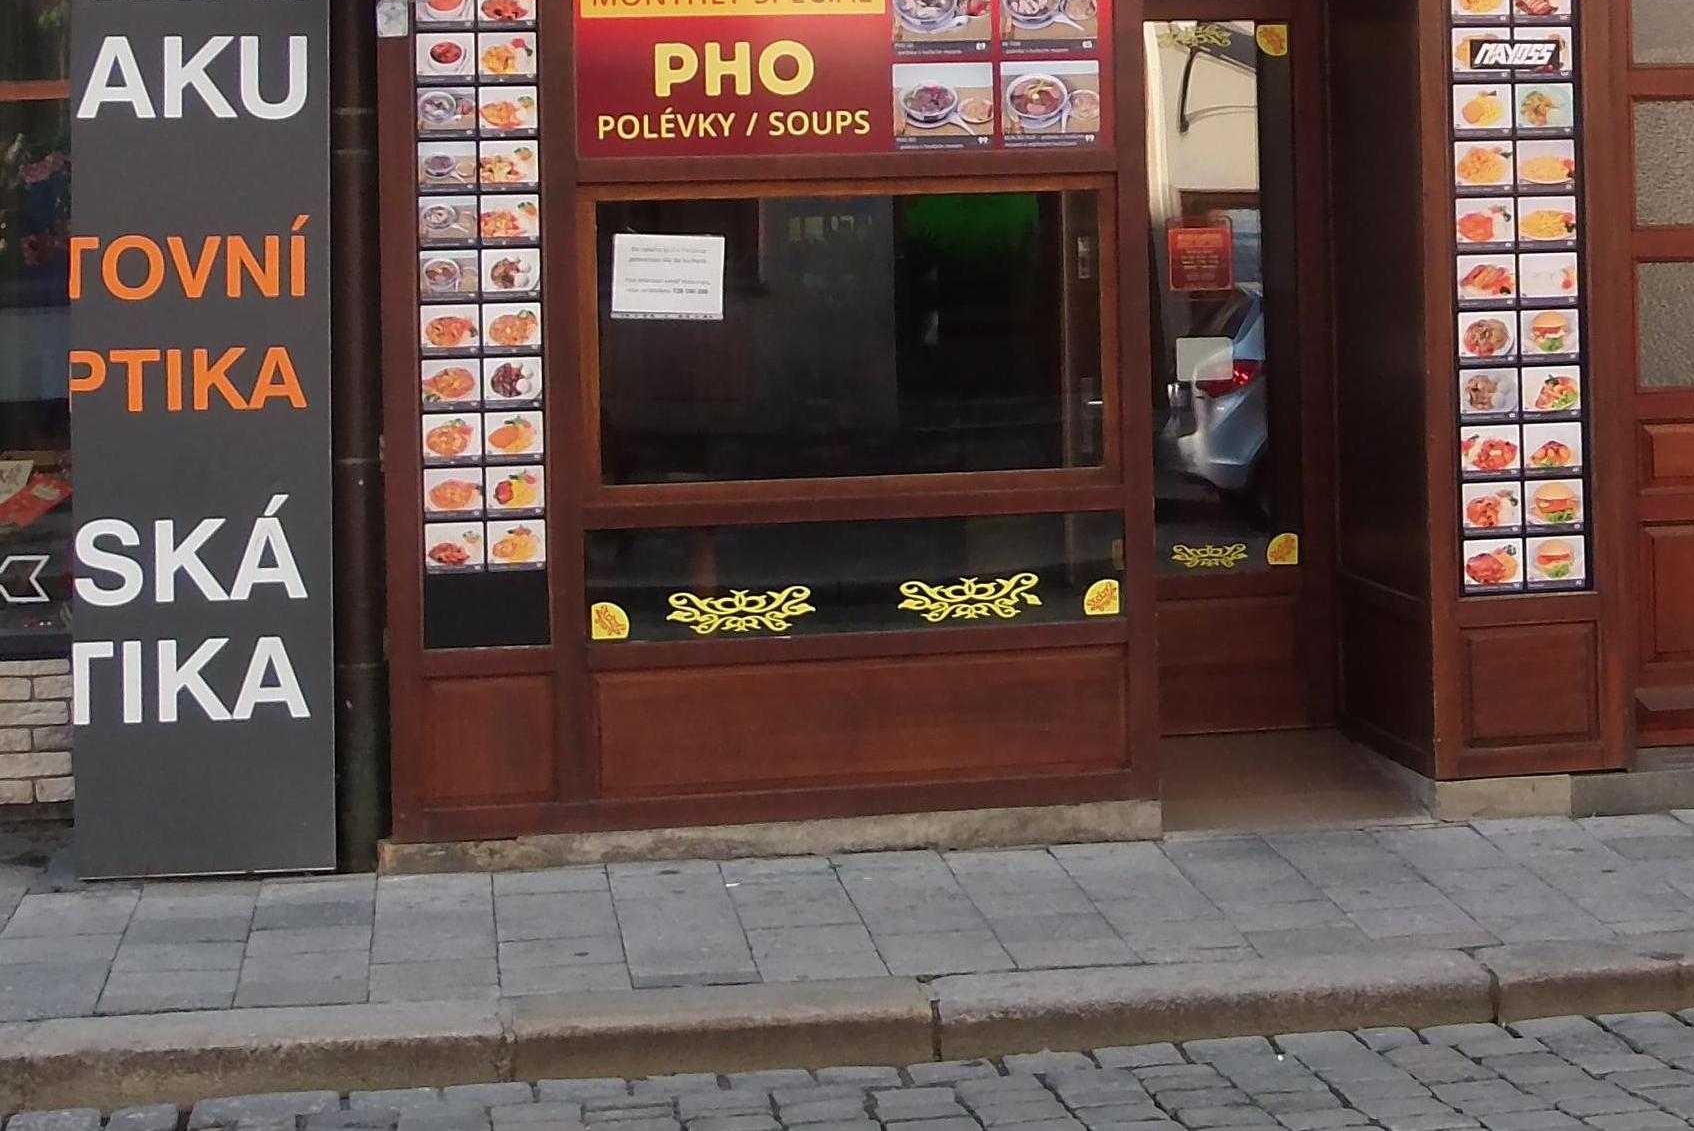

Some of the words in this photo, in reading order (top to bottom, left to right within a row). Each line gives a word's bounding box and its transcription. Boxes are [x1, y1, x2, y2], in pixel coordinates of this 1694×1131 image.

[76, 35, 309, 120] AKU
[653, 39, 815, 98] PHO
[597, 106, 737, 140] POLÉVKY
[768, 109, 871, 137] SOUPS
[73, 493, 309, 608] SKÁ
